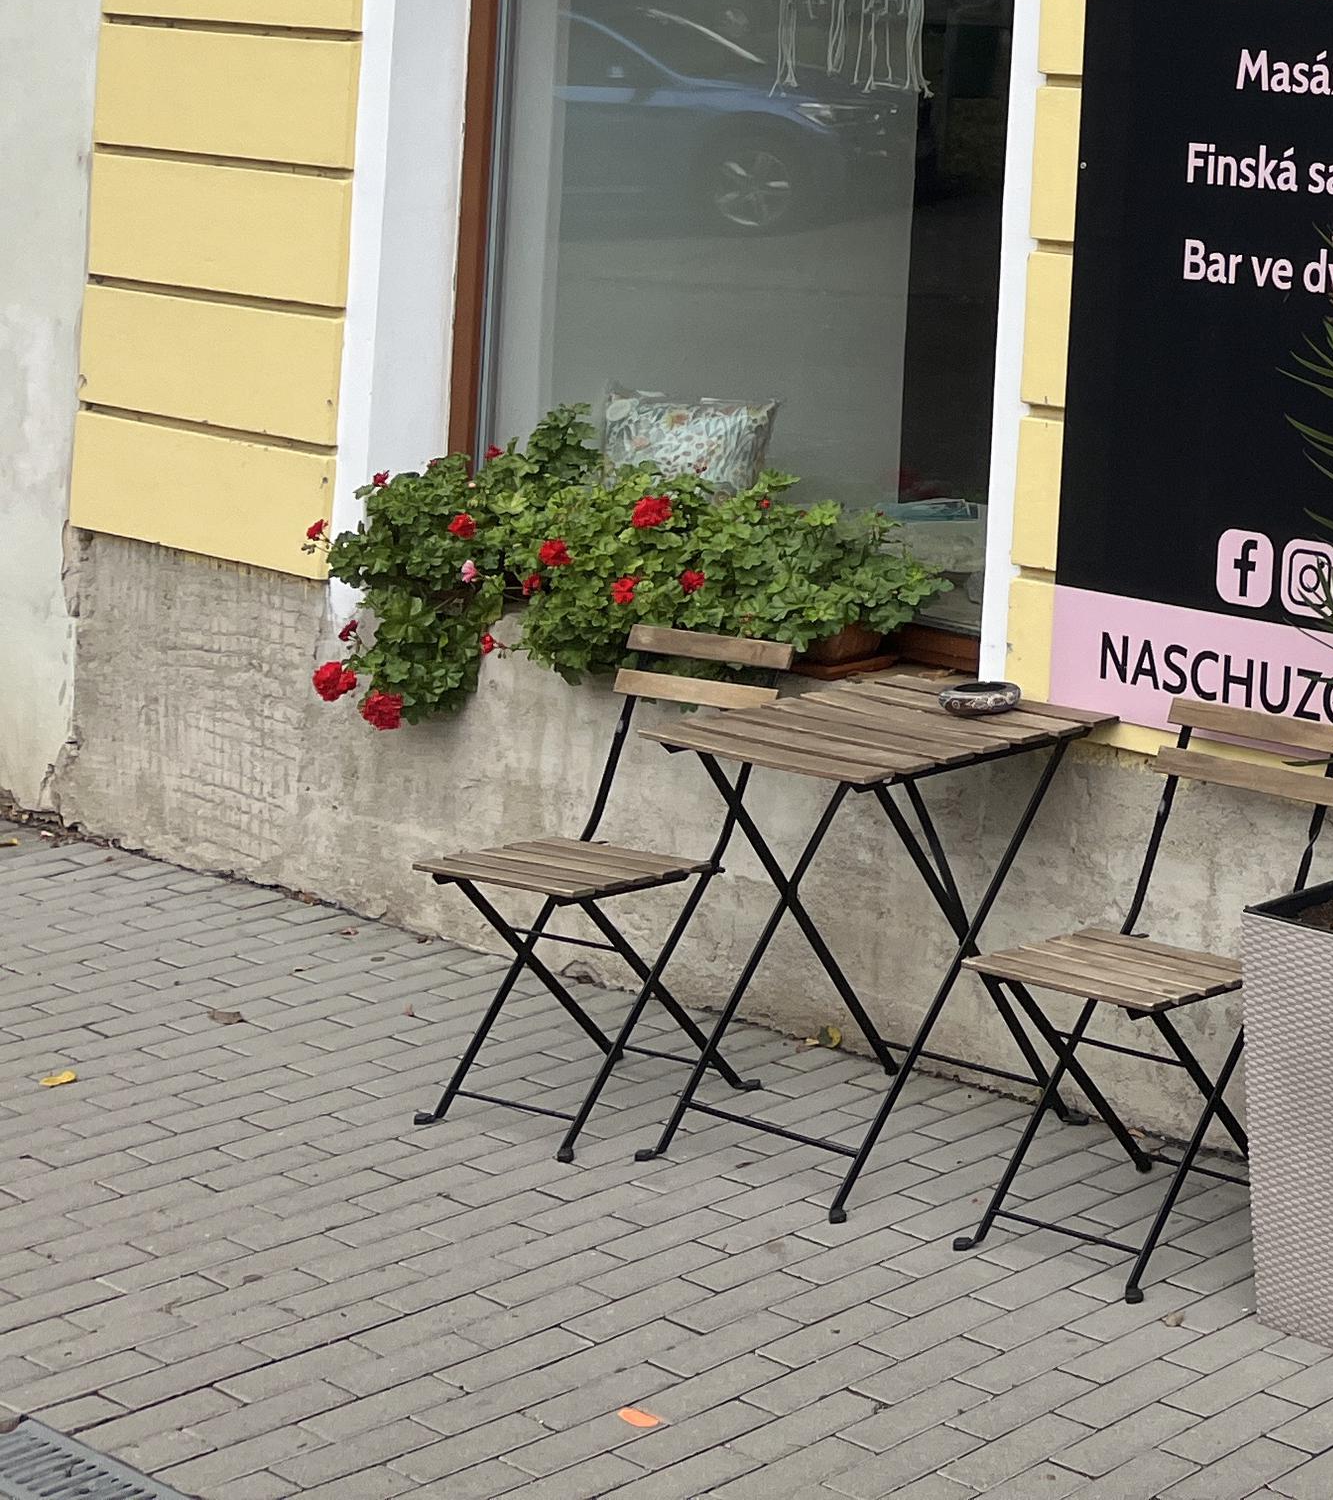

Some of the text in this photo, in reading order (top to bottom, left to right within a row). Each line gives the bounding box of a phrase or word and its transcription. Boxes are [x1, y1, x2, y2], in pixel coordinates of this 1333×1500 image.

[1186, 142, 1298, 192] Finská
[1183, 238, 1243, 284] Bar
[1251, 255, 1293, 290] ve
